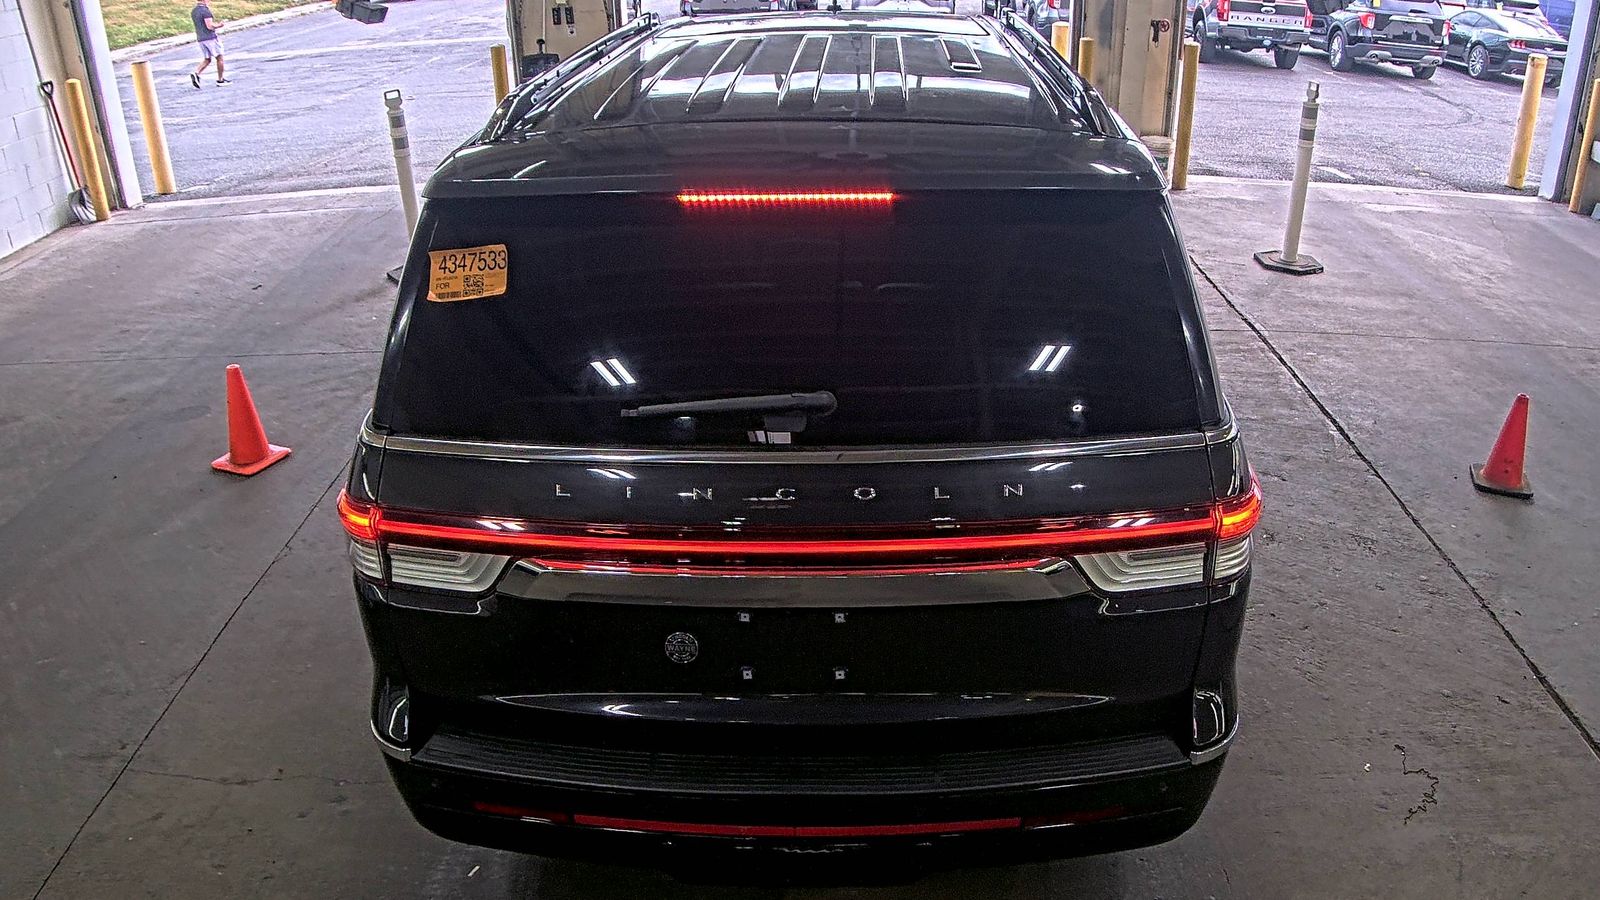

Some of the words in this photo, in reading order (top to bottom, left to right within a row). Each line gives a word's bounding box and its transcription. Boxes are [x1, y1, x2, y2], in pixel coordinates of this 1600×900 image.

[1230, 14, 1304, 26] RANGER
[438, 250, 507, 274] 4347533
[555, 483, 1024, 501] LINCOLN
